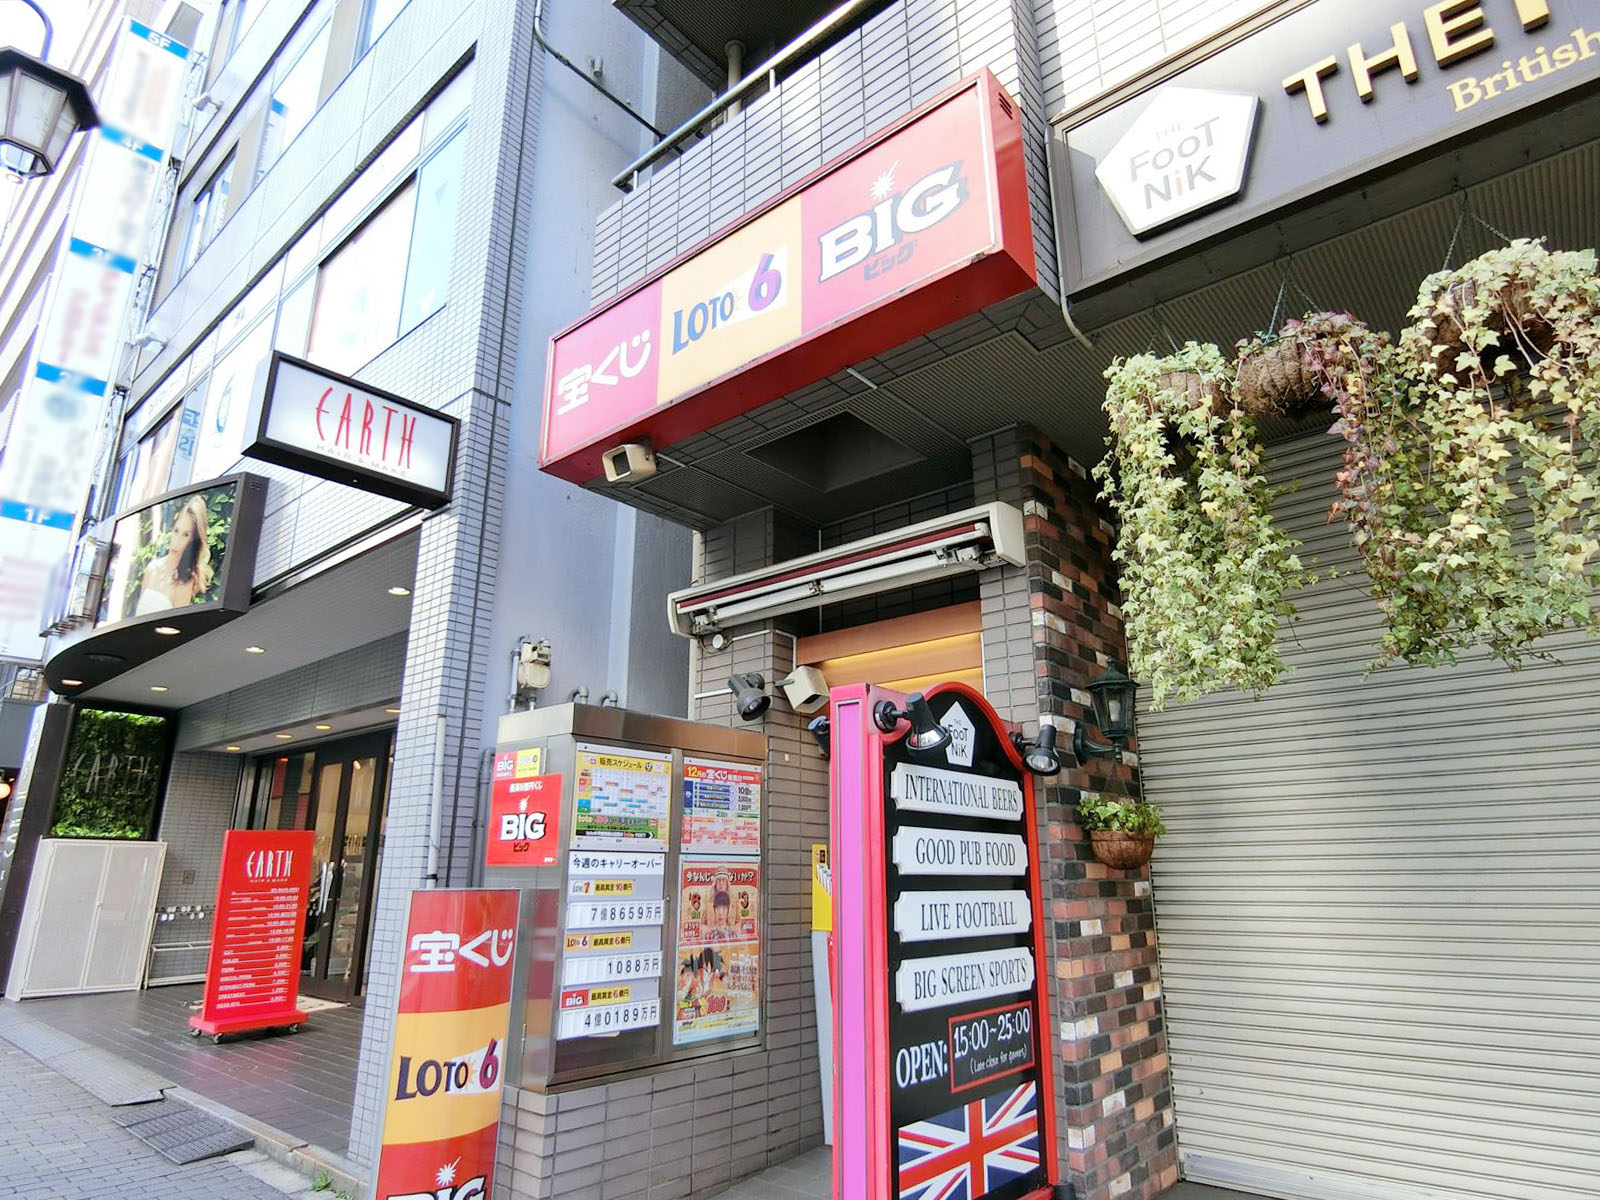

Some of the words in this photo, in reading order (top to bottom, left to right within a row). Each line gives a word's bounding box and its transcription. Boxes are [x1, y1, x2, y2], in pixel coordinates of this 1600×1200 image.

[148, 34, 171, 49] 5F
[1446, 28, 1600, 112] British
[1129, 116, 1220, 182] FOOT
[818, 160, 968, 283] BIG
[672, 291, 735, 356] LOTO
[748, 253, 782, 312] 6
[557, 329, 652, 416] 宝くじ
[315, 387, 417, 469] EARTH
[905, 773, 990, 809] INTERNATIONAL
[992, 787, 1018, 812] BEERS
[500, 811, 547, 841] BIG
[247, 850, 293, 878] EARTH
[573, 857, 662, 869] 今週のキャリーオーバー
[915, 837, 956, 865] GOOD
[960, 840, 982, 866] PUB
[985, 842, 1016, 866] FOOD
[921, 903, 951, 931] LIVE
[956, 901, 1017, 929] FOOTBALL
[409, 928, 514, 973] 宝くじ
[581, 936, 588, 947] 6
[608, 958, 660, 975] 1088万円
[914, 969, 937, 1000] BIG
[941, 962, 986, 995] SCREEN
[989, 957, 1027, 987] SPORTS
[565, 994, 584, 1006] BIG
[395, 1055, 469, 1101] LOTO
[479, 1037, 499, 1089] 6
[896, 1039, 948, 1088] OPEN:
